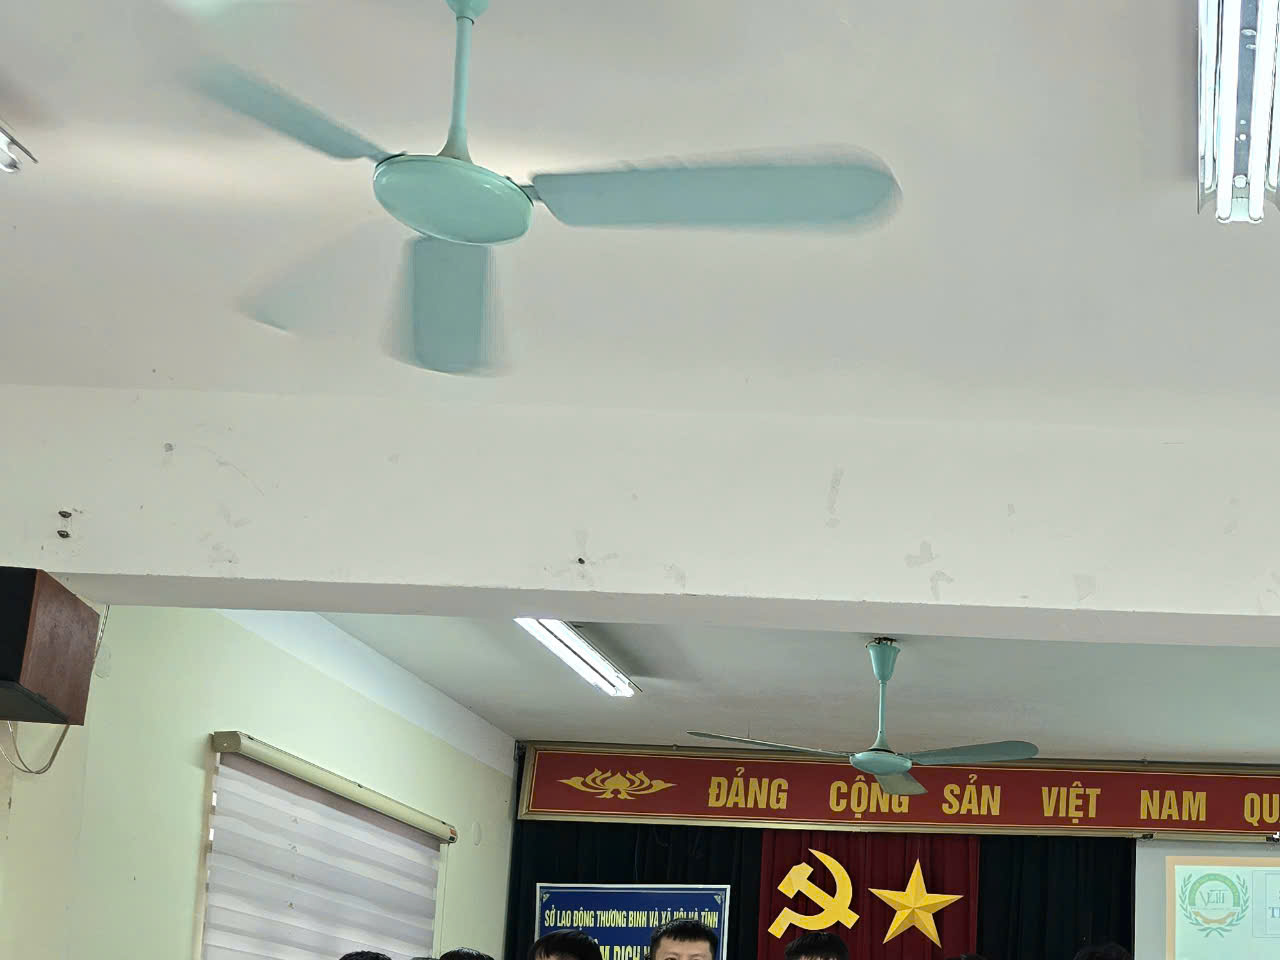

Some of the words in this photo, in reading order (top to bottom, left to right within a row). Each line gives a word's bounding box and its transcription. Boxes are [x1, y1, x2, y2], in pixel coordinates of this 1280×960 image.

[708, 767, 789, 809] ĐẢNG
[830, 775, 909, 818] CỘNG
[942, 774, 1000, 815] SẢN
[1042, 781, 1101, 823] VIỆT
[1140, 790, 1207, 821] NAM
[544, 904, 556, 927] SỞ
[557, 910, 571, 927] LAO
[573, 906, 595, 931] ĐỘNG
[596, 909, 626, 927] THƯƠNG
[628, 910, 647, 927] BINH
[649, 907, 659, 927] VÀ
